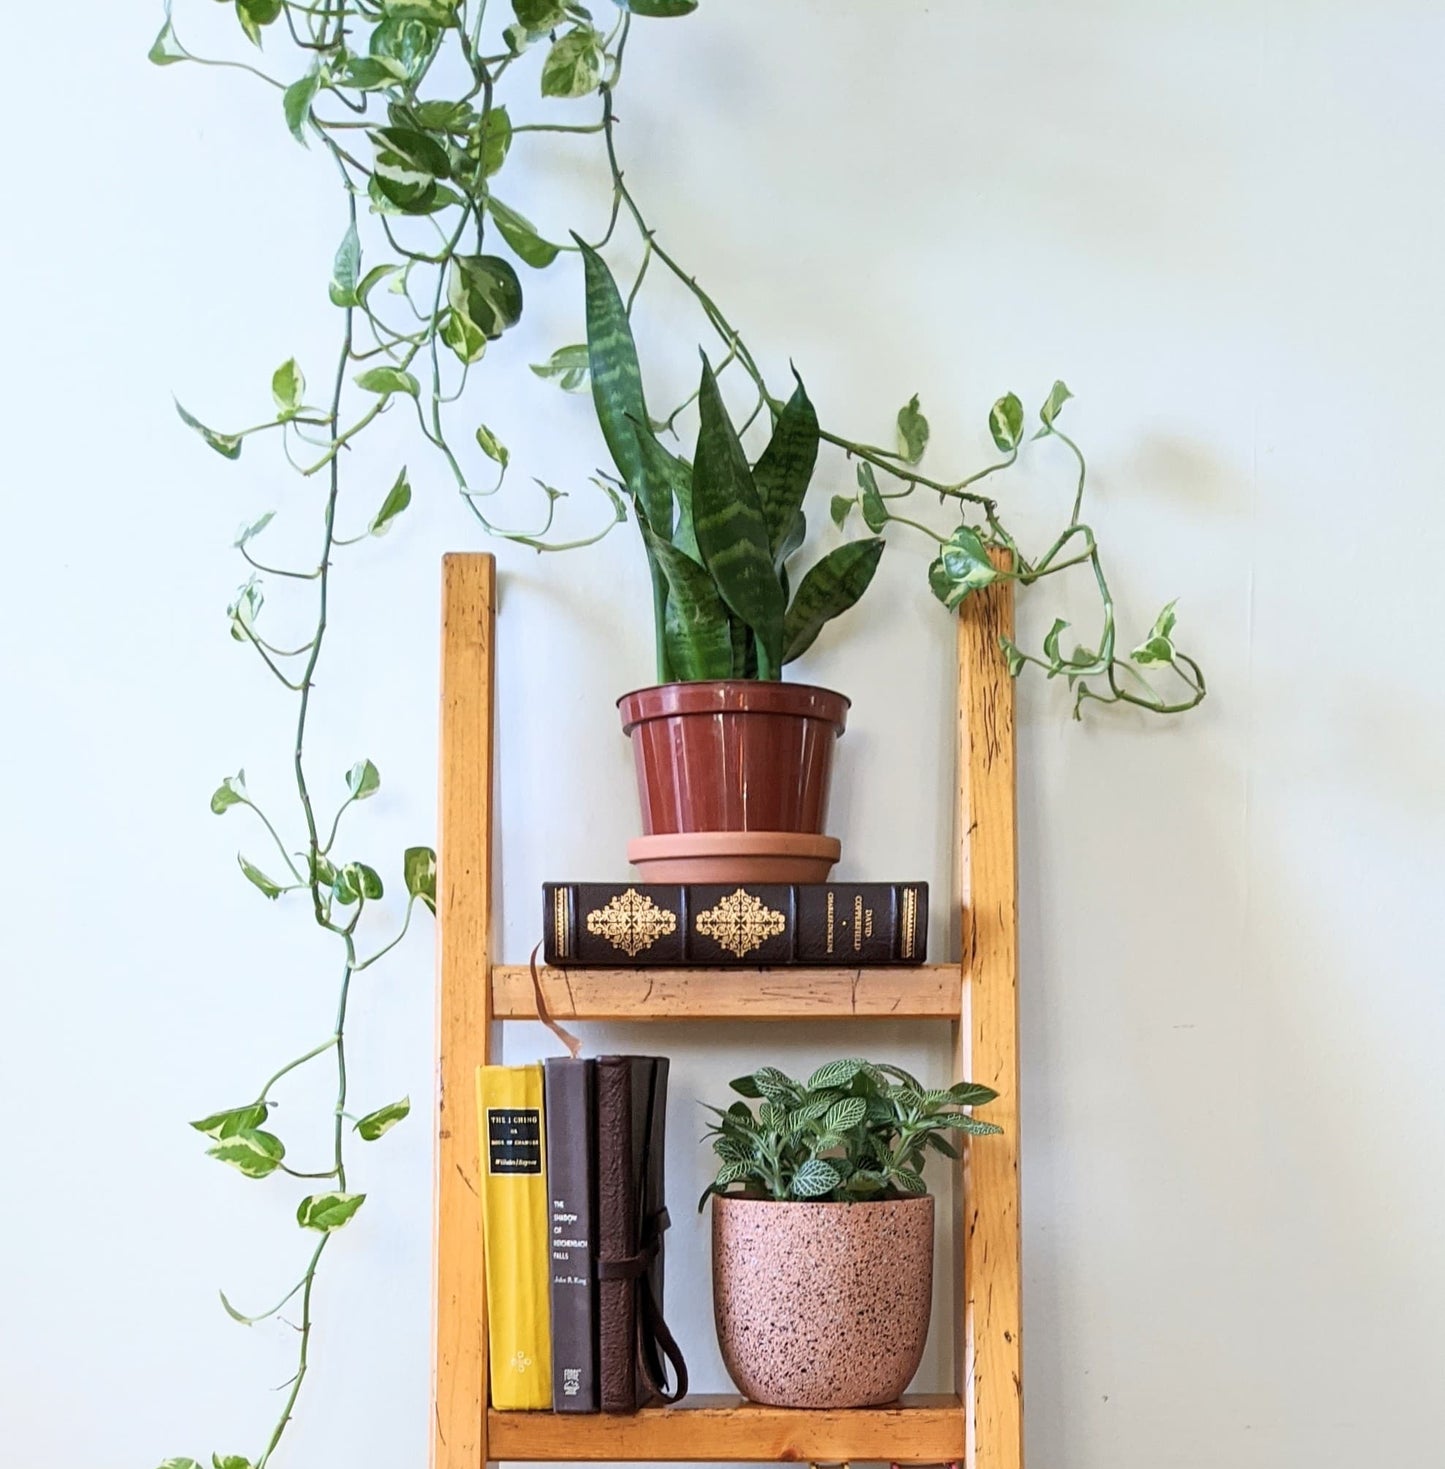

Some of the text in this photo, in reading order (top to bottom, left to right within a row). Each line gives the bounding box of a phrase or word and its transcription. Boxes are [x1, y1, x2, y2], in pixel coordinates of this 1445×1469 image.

[854, 895, 862, 950] COPPERFIELD
[553, 1201, 564, 1209] THE
[553, 1214, 578, 1225] SHADOW
[553, 1252, 569, 1260] FALLS
